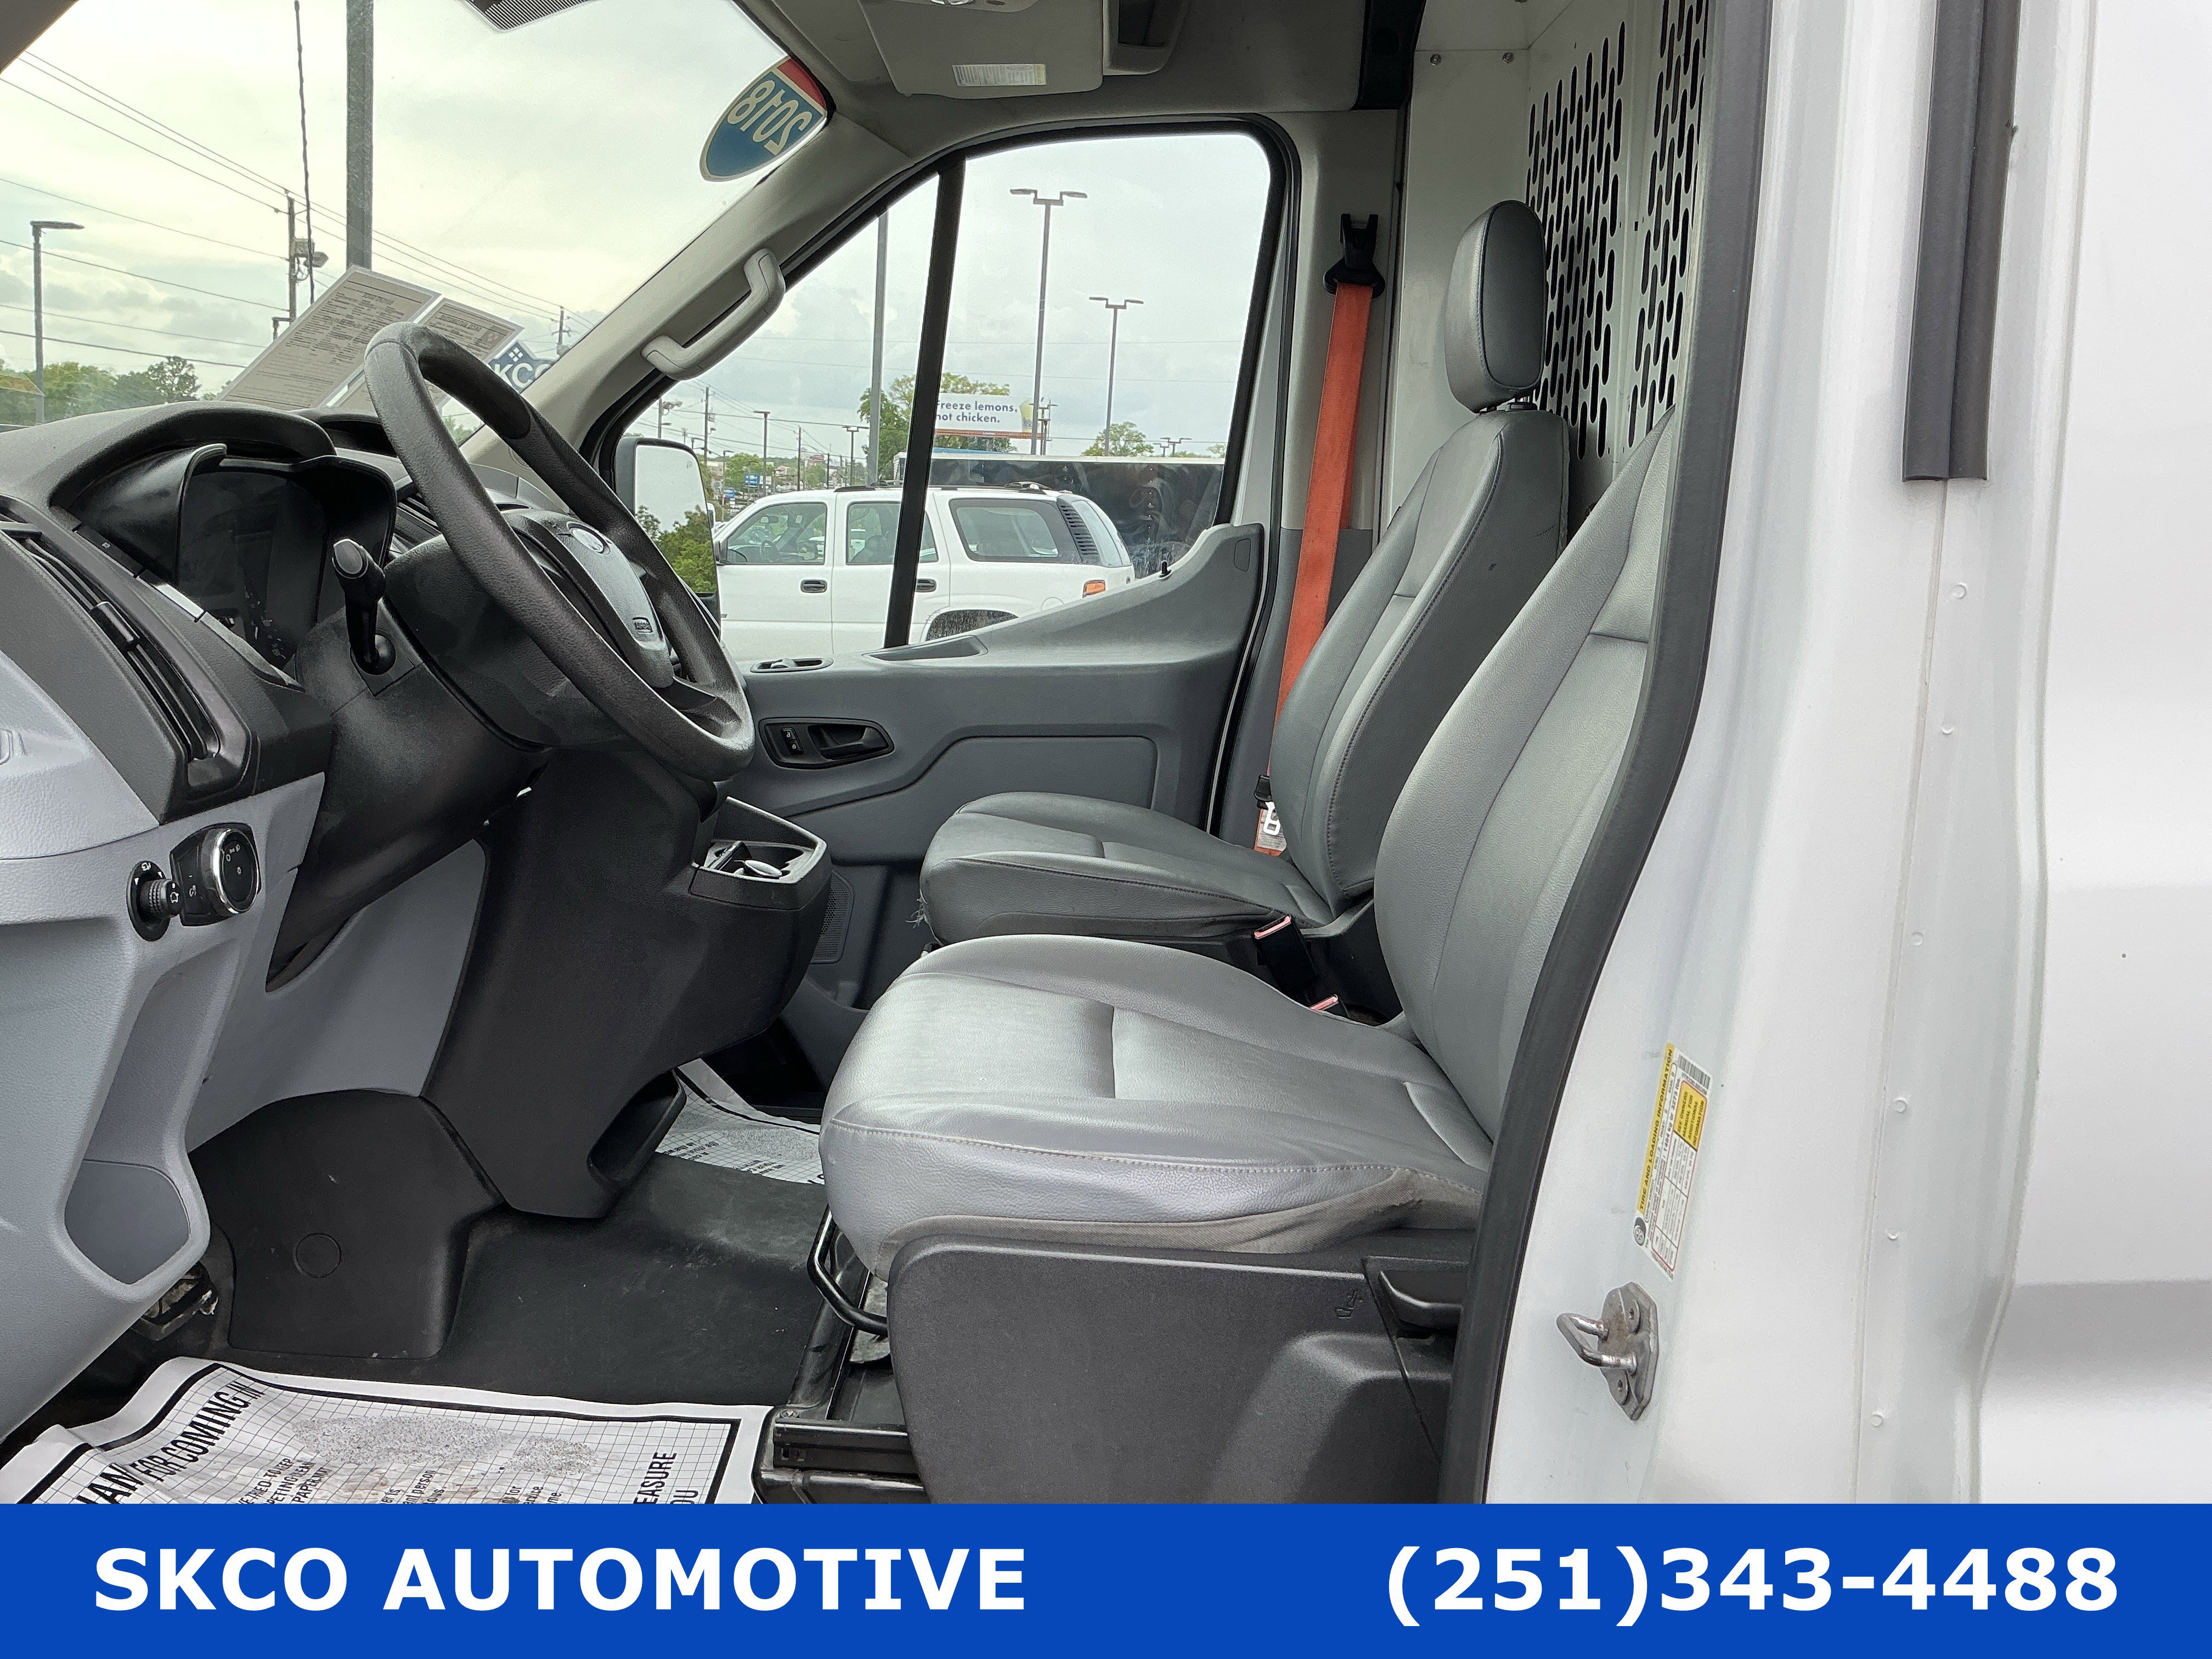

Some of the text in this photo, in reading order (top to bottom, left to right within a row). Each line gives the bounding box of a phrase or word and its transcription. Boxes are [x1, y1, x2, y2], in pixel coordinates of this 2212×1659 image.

[956, 412, 1000, 422] chicken.
[975, 401, 1018, 413] lemons,
[1648, 1120, 1660, 1163] LOADING
[1657, 1048, 1673, 1118] INFORMATION
[1679, 1092, 1688, 1119] OWNERS
[1687, 1101, 1698, 1139] ADDITIONAL
[1681, 1110, 1690, 1137] MANUAL
[1692, 1100, 1705, 1146] INFORMATION
[131, 1455, 178, 1482] FOR
[160, 1390, 252, 1467] COMING
